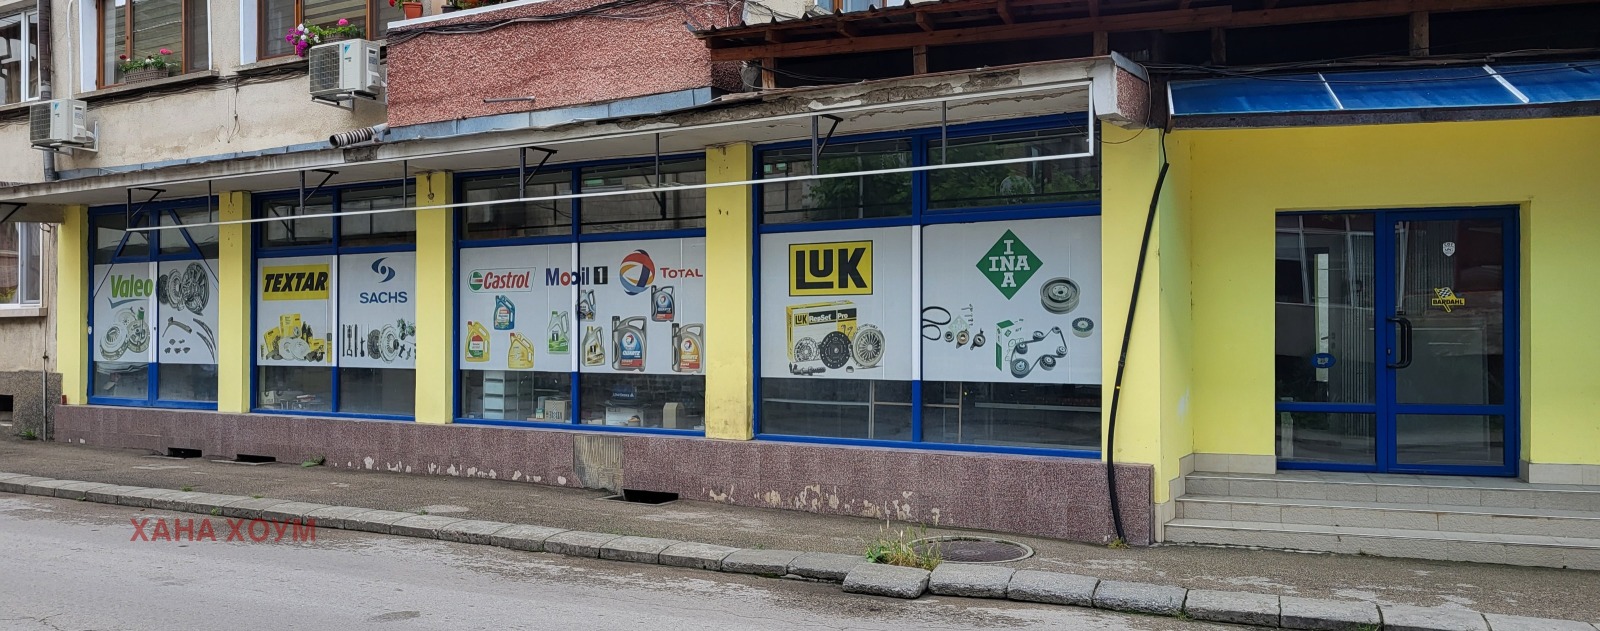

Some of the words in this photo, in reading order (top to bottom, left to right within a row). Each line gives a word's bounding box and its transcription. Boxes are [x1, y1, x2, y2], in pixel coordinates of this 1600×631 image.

[988, 255, 1031, 271] INA
[264, 272, 328, 292] TEXTAR
[484, 271, 530, 289] Castrol
[546, 267, 589, 286] Mobil
[111, 274, 153, 298] Valeo
[360, 291, 408, 304] SACHS
